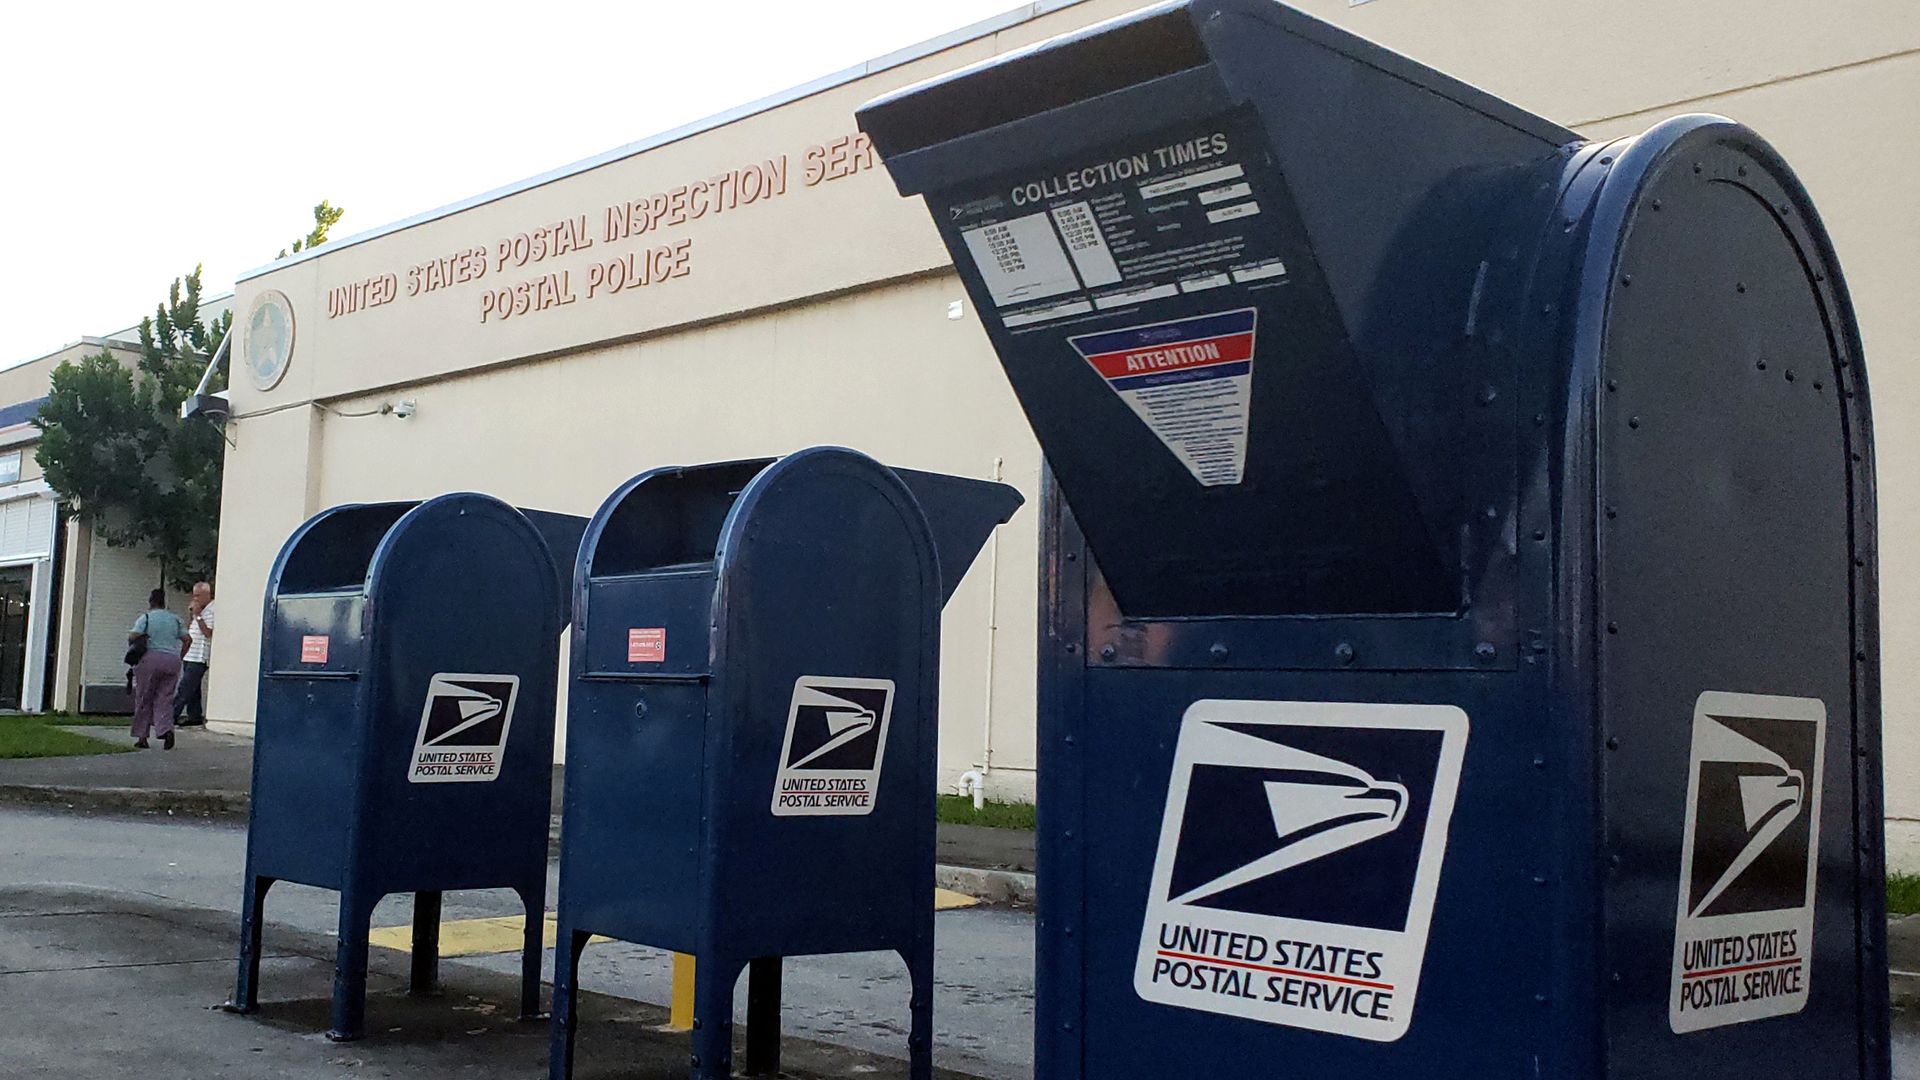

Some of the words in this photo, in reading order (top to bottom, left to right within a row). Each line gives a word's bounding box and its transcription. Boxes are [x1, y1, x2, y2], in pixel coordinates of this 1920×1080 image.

[1011, 153, 1150, 206] COLLECTION
[1153, 133, 1228, 169] TIMES
[327, 272, 397, 319] UNITED
[407, 246, 487, 297] STATES
[496, 215, 593, 272] POSTAL
[603, 154, 787, 243] INSPECTION
[480, 270, 576, 323] POSTAL
[586, 238, 692, 299] POLICE
[1126, 343, 1220, 371] ATTENTION
[415, 766, 453, 776] POSTAL
[454, 765, 495, 775] SERVICE
[418, 753, 458, 763] UNITED
[458, 752, 494, 762] STATES
[779, 795, 822, 807] POSTAL
[824, 795, 869, 807] SERVICE
[782, 778, 826, 791] UNITED
[827, 778, 867, 791] STATES
[1159, 923, 1268, 962] UNITED
[1272, 940, 1383, 980] STATES
[1683, 936, 1744, 970] UNITED
[1746, 929, 1797, 962] STATES
[1152, 958, 1257, 1000] POSTAL
[1264, 976, 1393, 1022] SERVICE
[1680, 975, 1739, 1012] POSTAL
[1742, 965, 1802, 1001] SERVICE
